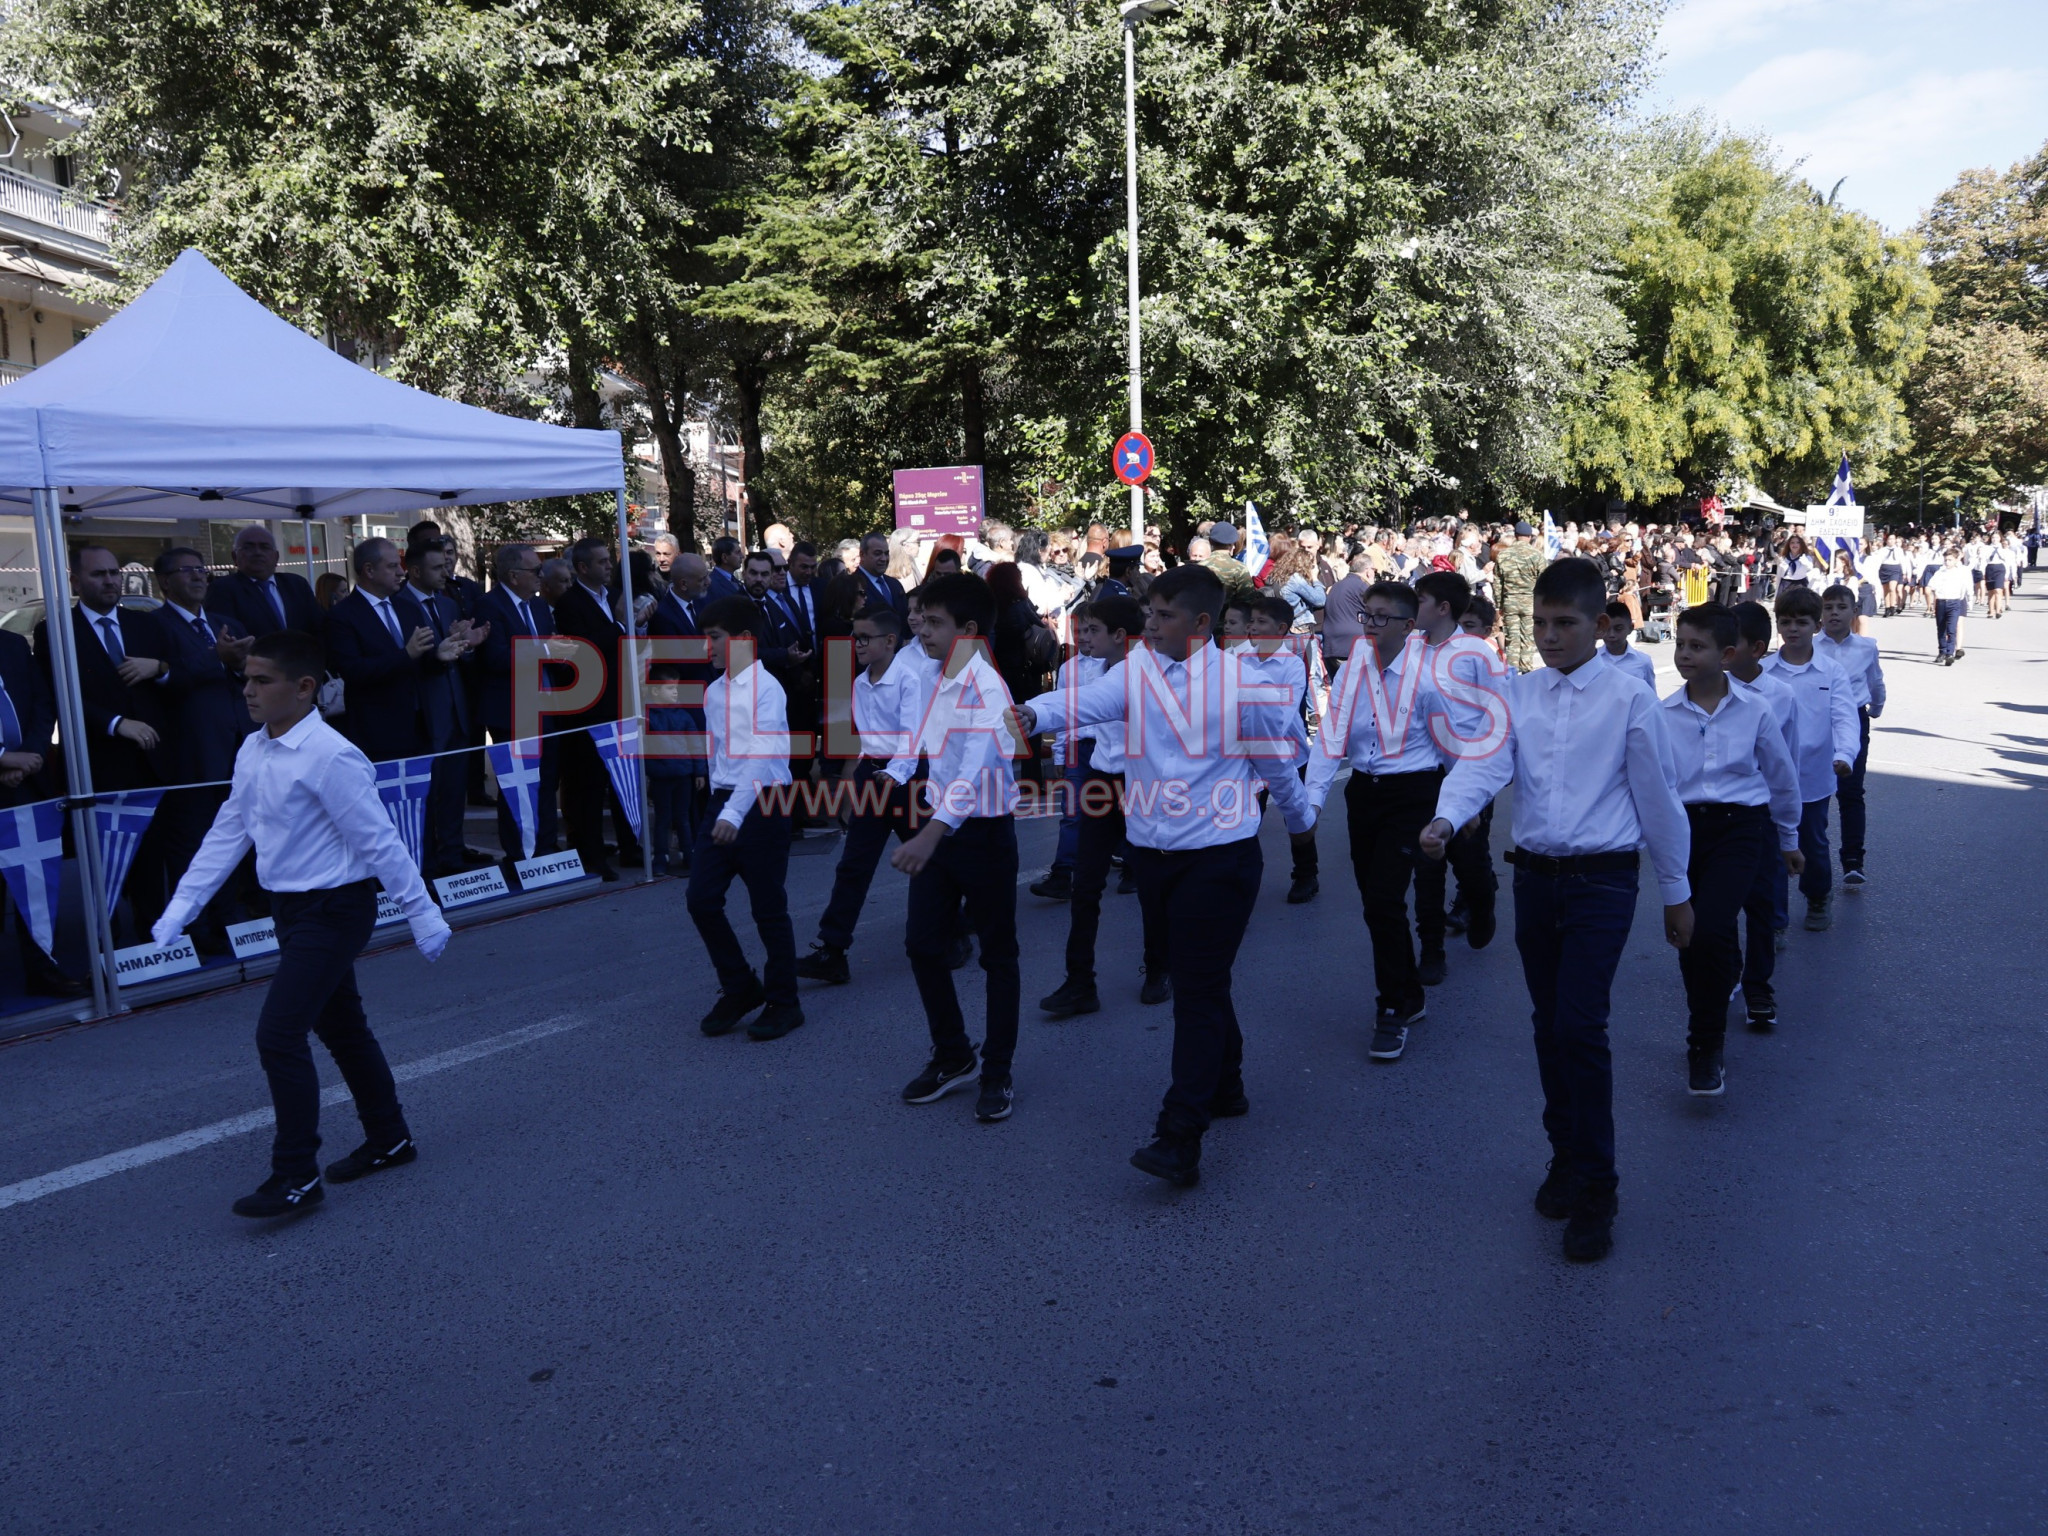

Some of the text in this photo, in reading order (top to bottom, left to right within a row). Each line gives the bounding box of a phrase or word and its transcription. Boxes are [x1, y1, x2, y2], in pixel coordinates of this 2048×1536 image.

[520, 858, 581, 880] ΒΟΥΛΕΥΤΕΣ
[448, 872, 491, 889] ΠΡΟΕΔΡΟΣ
[453, 881, 505, 901] ΚΟΙΝΟΤΗΤΑΣ
[235, 927, 278, 947] ΑΝΤΙΠΕΡΙΦ
